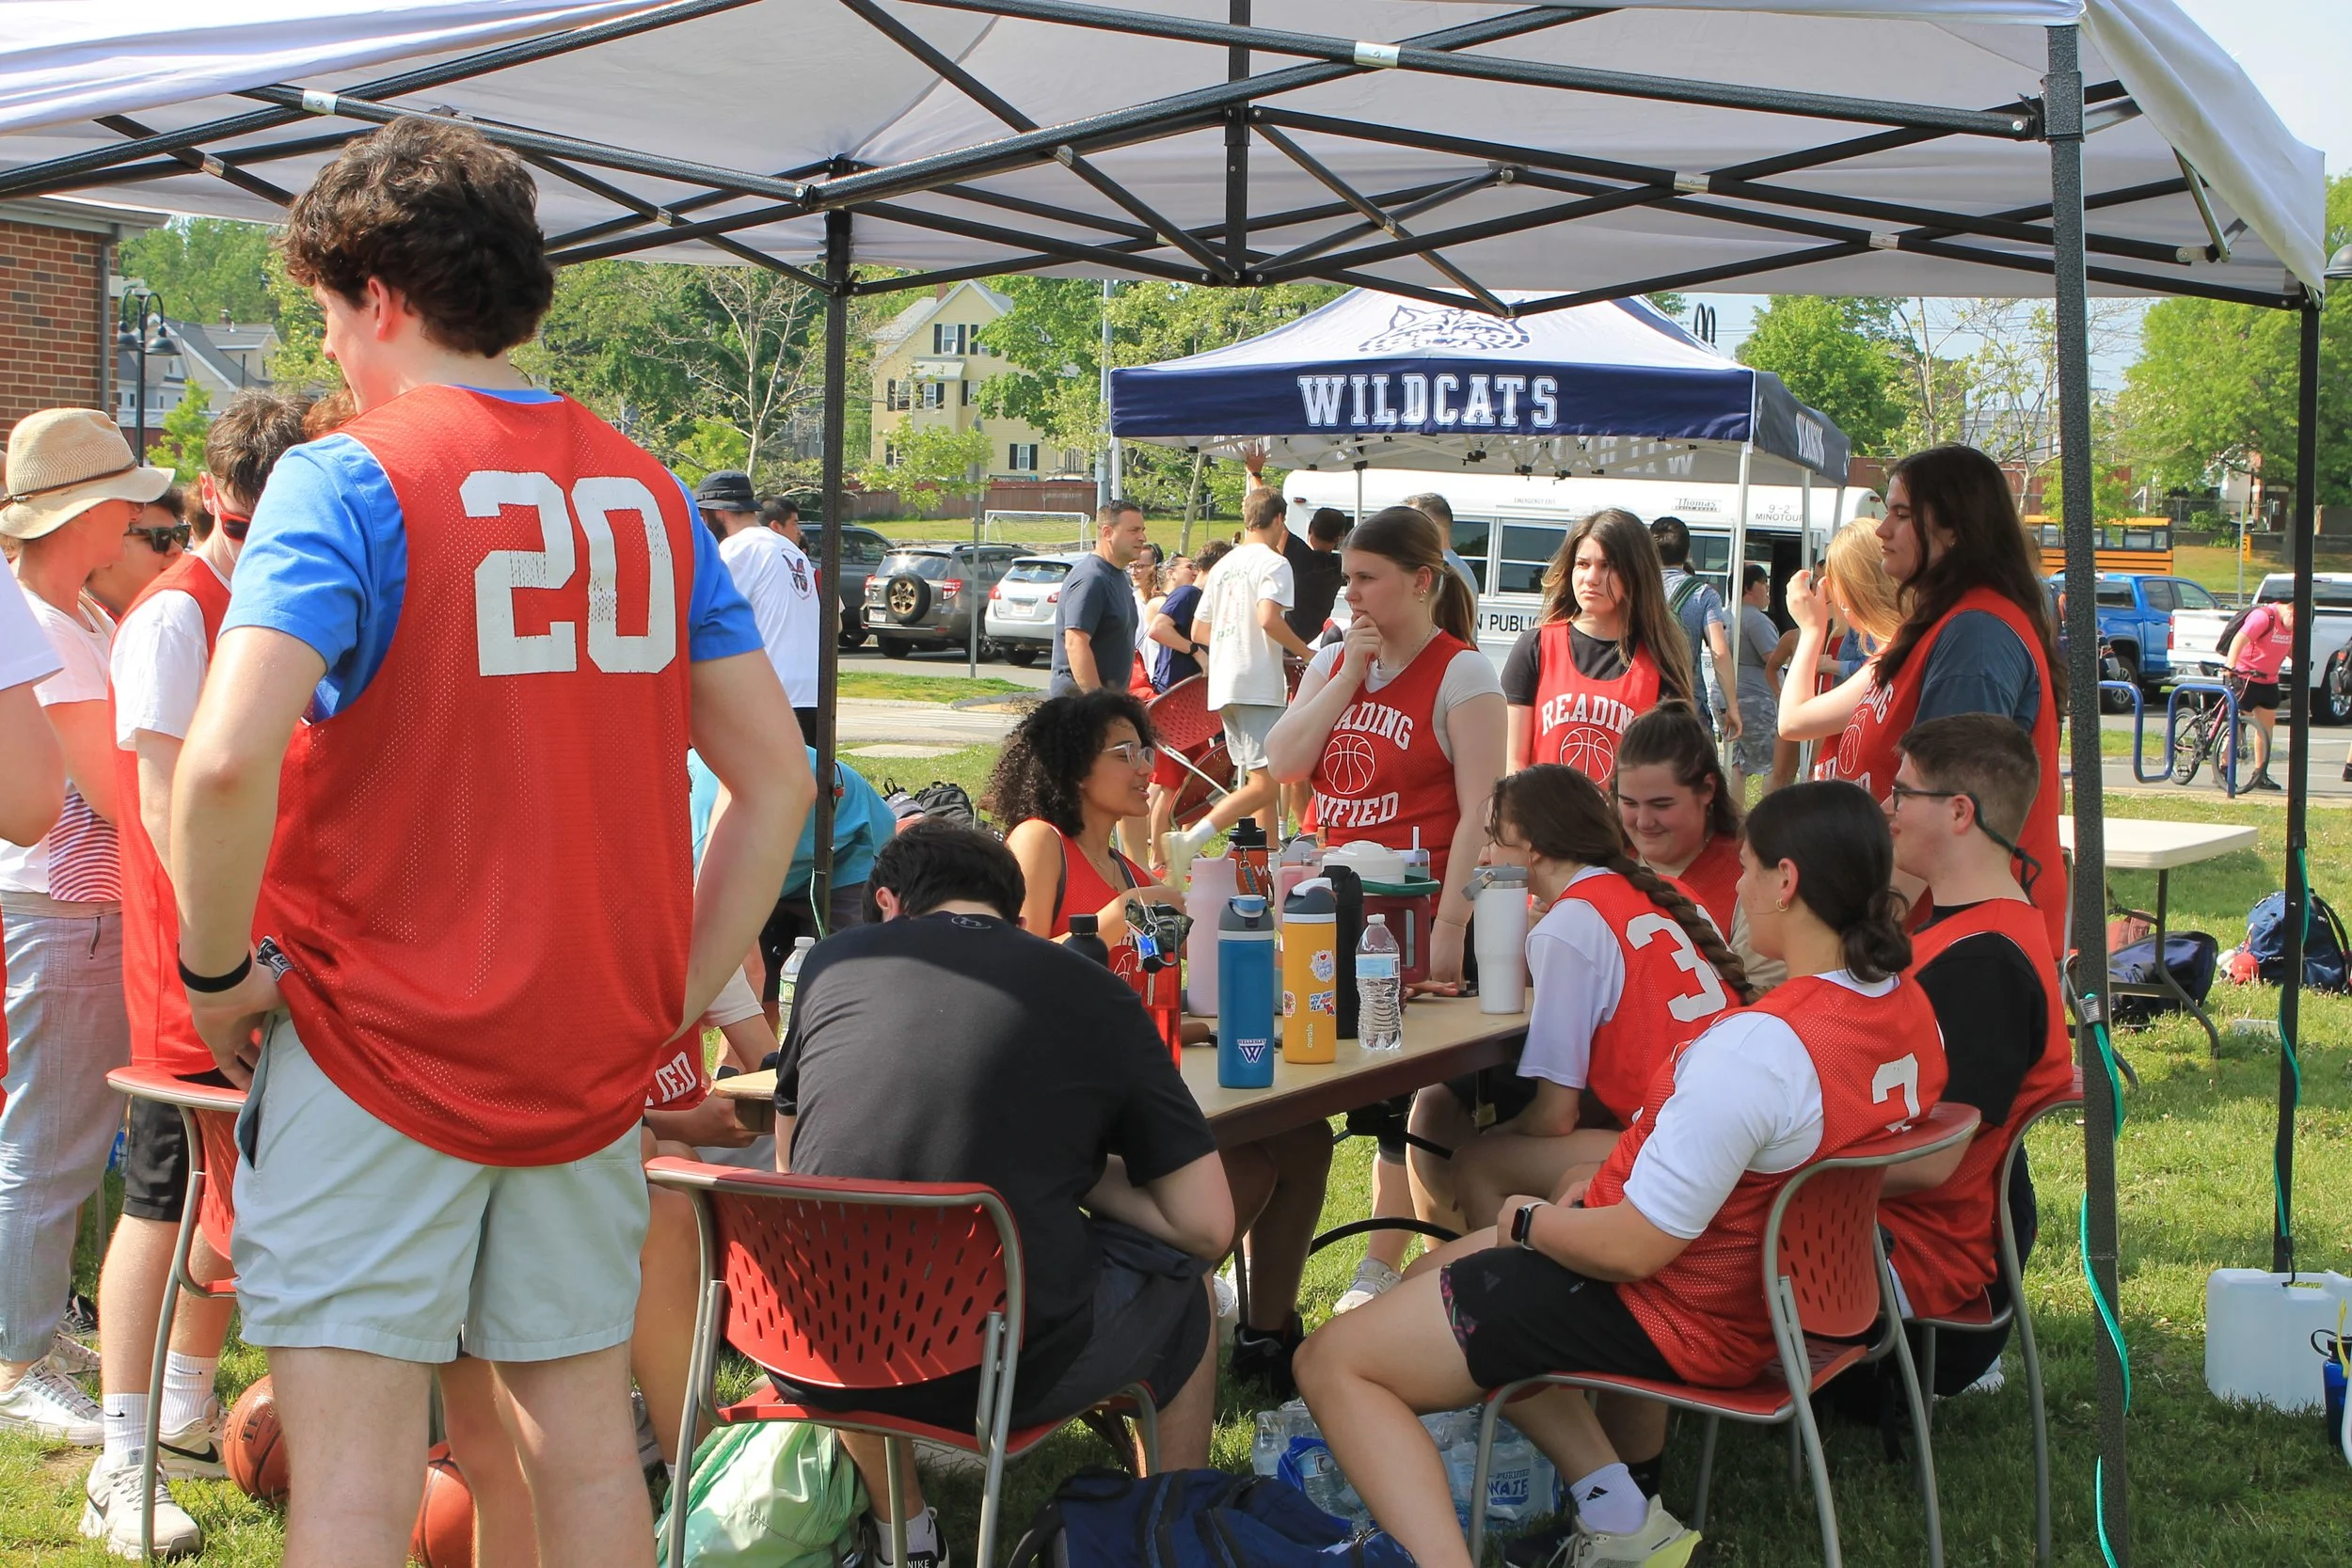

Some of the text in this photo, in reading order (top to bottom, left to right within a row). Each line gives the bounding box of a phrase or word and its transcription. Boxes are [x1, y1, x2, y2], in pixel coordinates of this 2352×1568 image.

[1297, 373, 1558, 428] WILDCATS
[1677, 498, 1716, 507] Thomas
[459, 470, 676, 677] 20
[1334, 701, 1414, 751] ADING
[1542, 693, 1636, 736] READIN
[1311, 790, 1399, 828] NIFIED
[1239, 1045, 1264, 1063] W
[1487, 1479, 1529, 1497] WATE
[907, 1559, 930, 1568] NIKE
